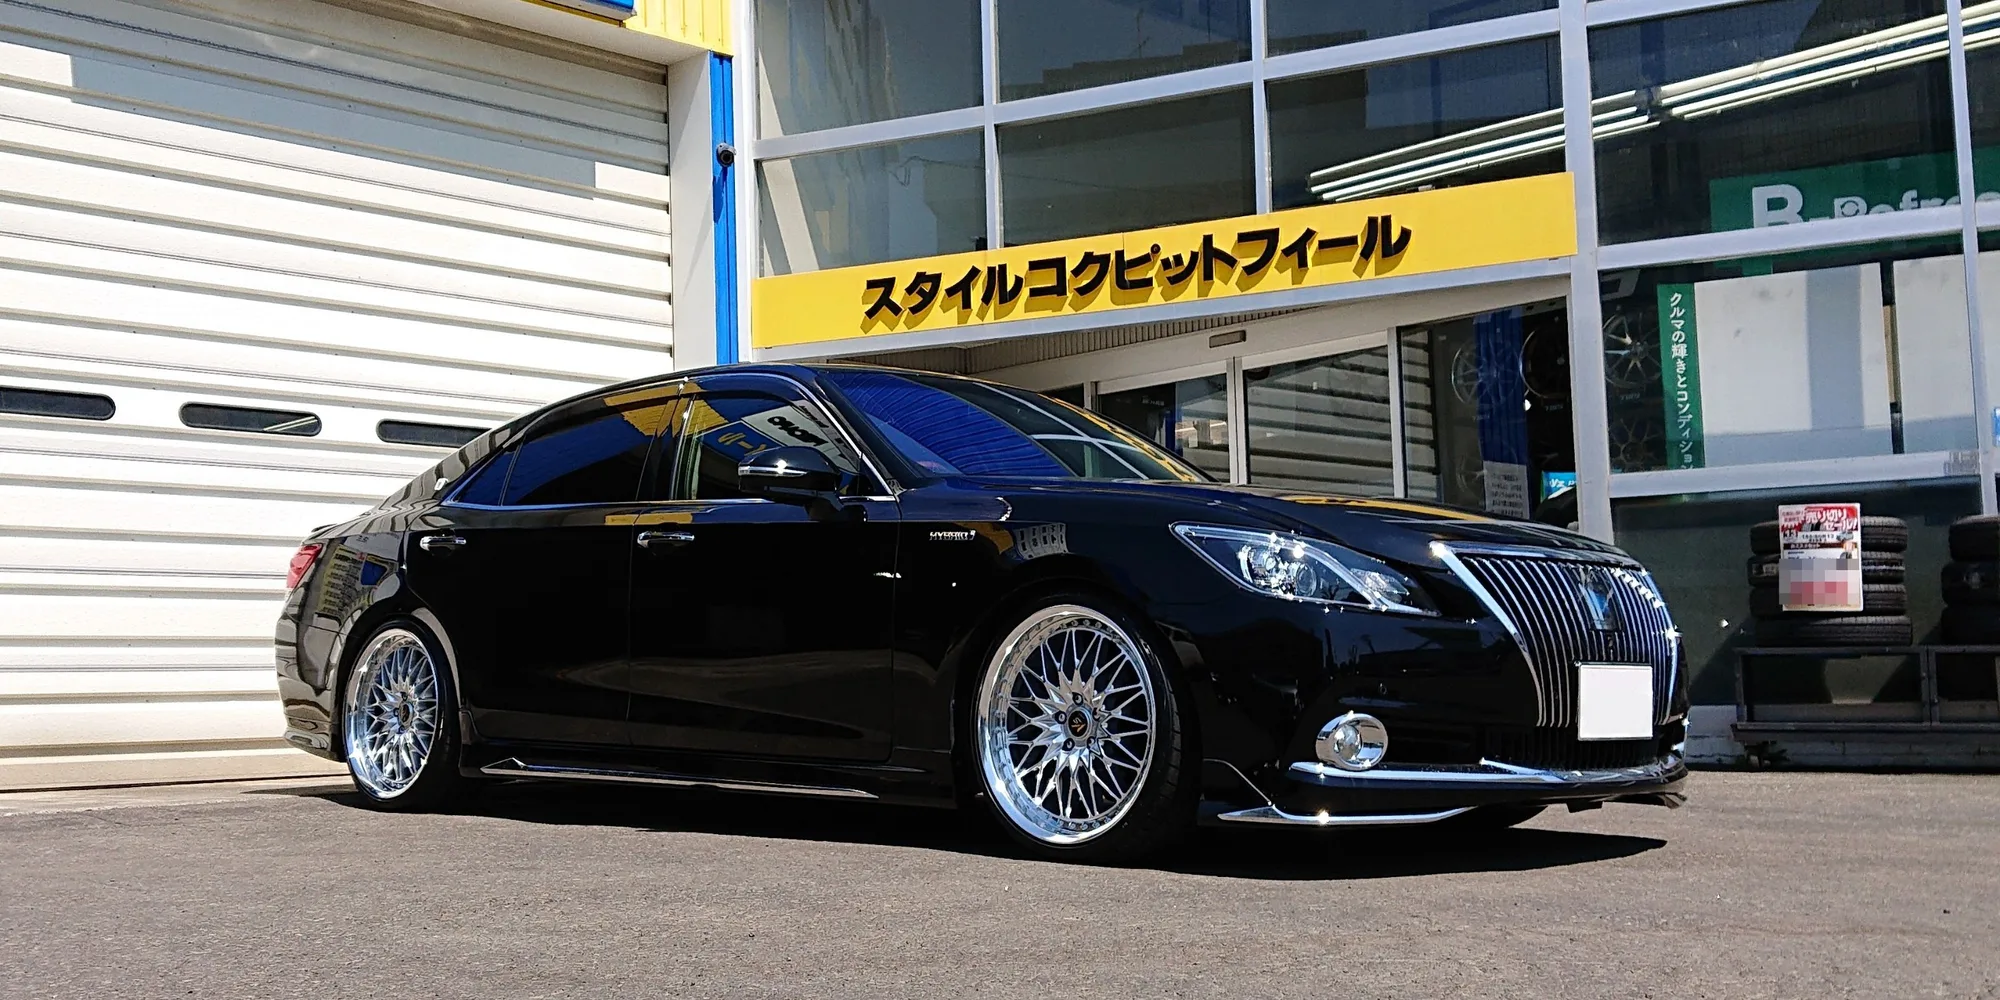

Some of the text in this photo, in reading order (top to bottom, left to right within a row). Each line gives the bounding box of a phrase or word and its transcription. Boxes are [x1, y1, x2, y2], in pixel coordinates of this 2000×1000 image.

[1752, 184, 2000, 228] B-Rfr
[864, 214, 1412, 320] スタイルコクピットフィール
[1805, 508, 1847, 524] 売り切り
